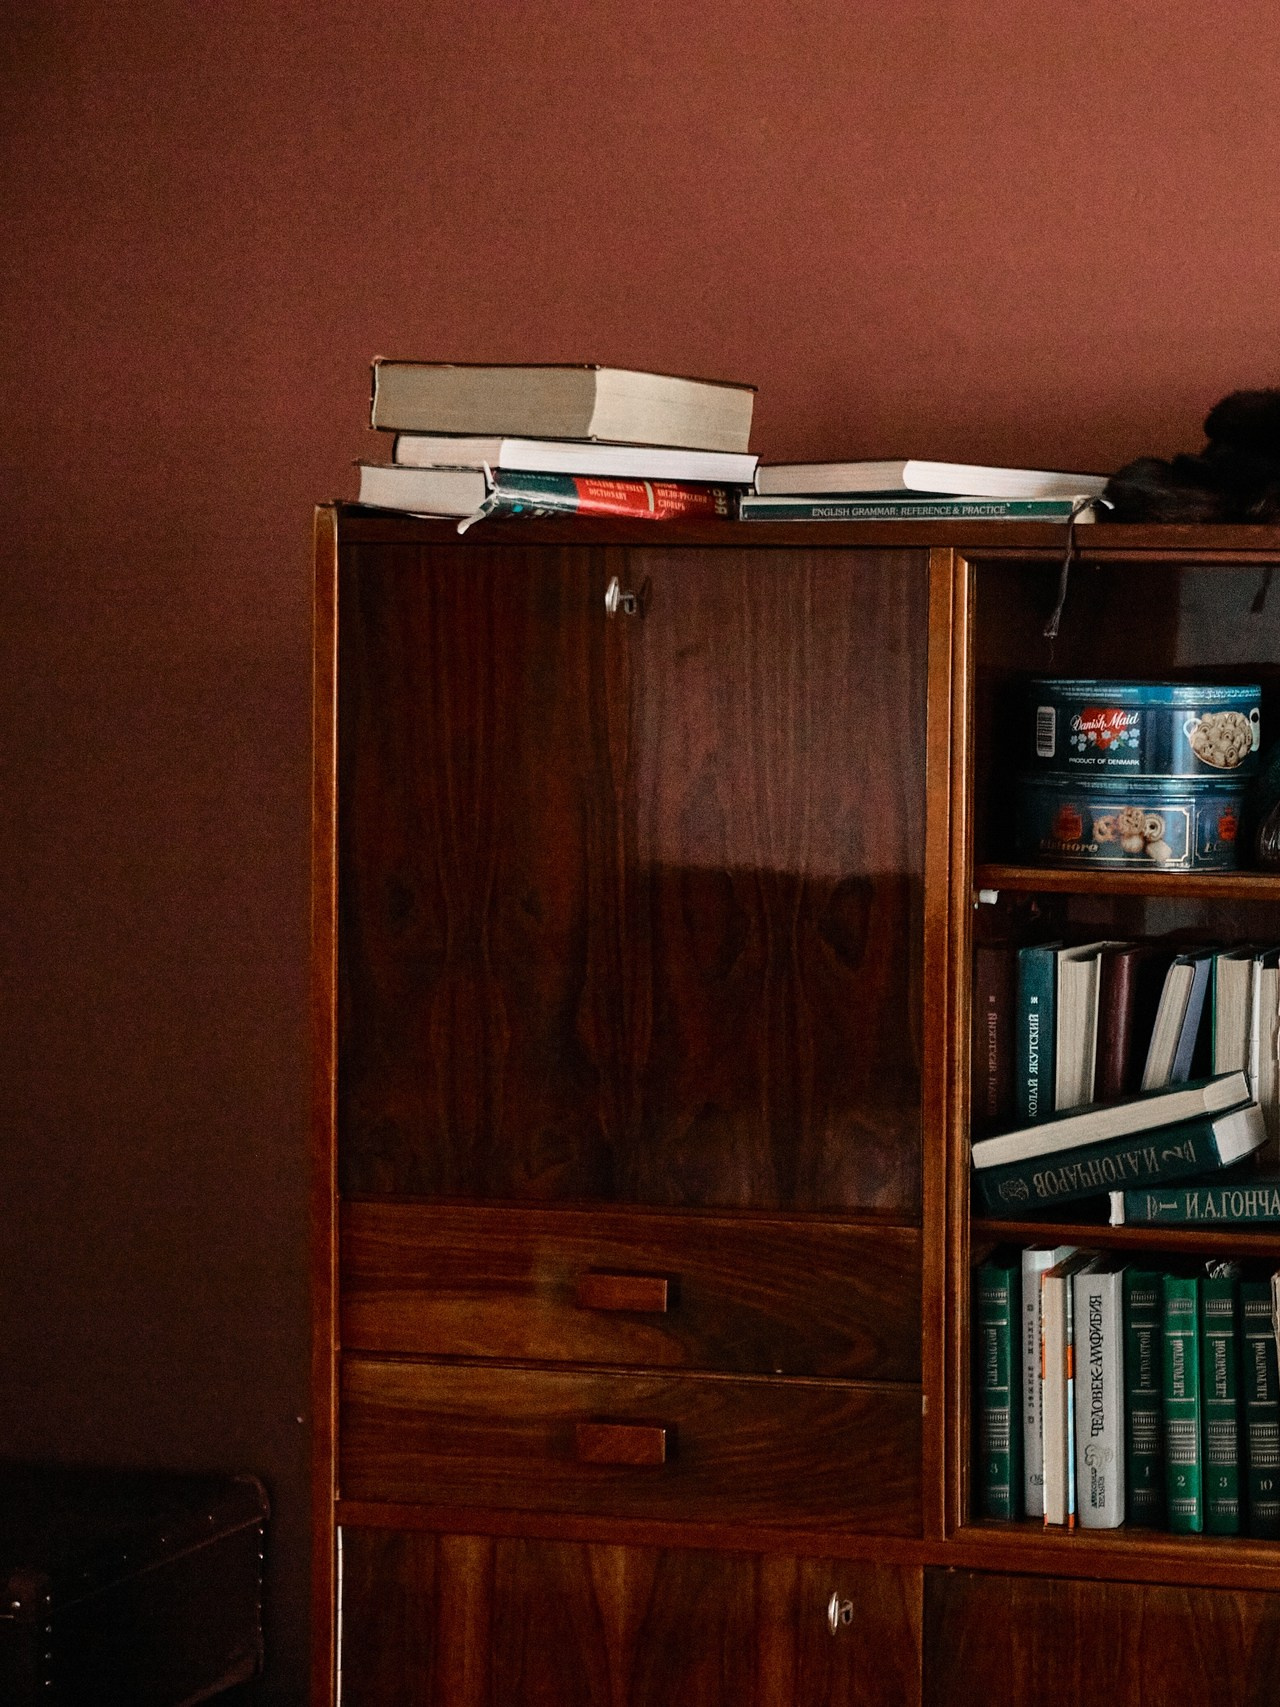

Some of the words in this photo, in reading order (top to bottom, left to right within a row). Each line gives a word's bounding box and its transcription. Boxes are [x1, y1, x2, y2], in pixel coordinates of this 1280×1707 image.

[812, 507, 850, 517] ENGLISH
[851, 506, 899, 516] GRAMMAR:
[900, 505, 952, 516] REFERENCE
[952, 506, 960, 515] &
[962, 504, 1006, 515] PRACTICE
[1069, 712, 1106, 732] Danish
[1109, 711, 1139, 727] Maid
[1068, 757, 1097, 765] PRODUCT
[1108, 758, 1140, 766] DENMARK
[1028, 1013, 1039, 1075] ЯКУТСКИЙ
[1027, 1078, 1039, 1118] КОЛАЙ
[1032, 1147, 1160, 1198] И.А.ГОНЧАРОВ
[1089, 1294, 1105, 1437] ЧЕЛОВЕК-АМФИБИЯ
[1176, 1475, 1186, 1487] 2
[1219, 1476, 1228, 1488] 3
[1259, 1479, 1273, 1490] 10
